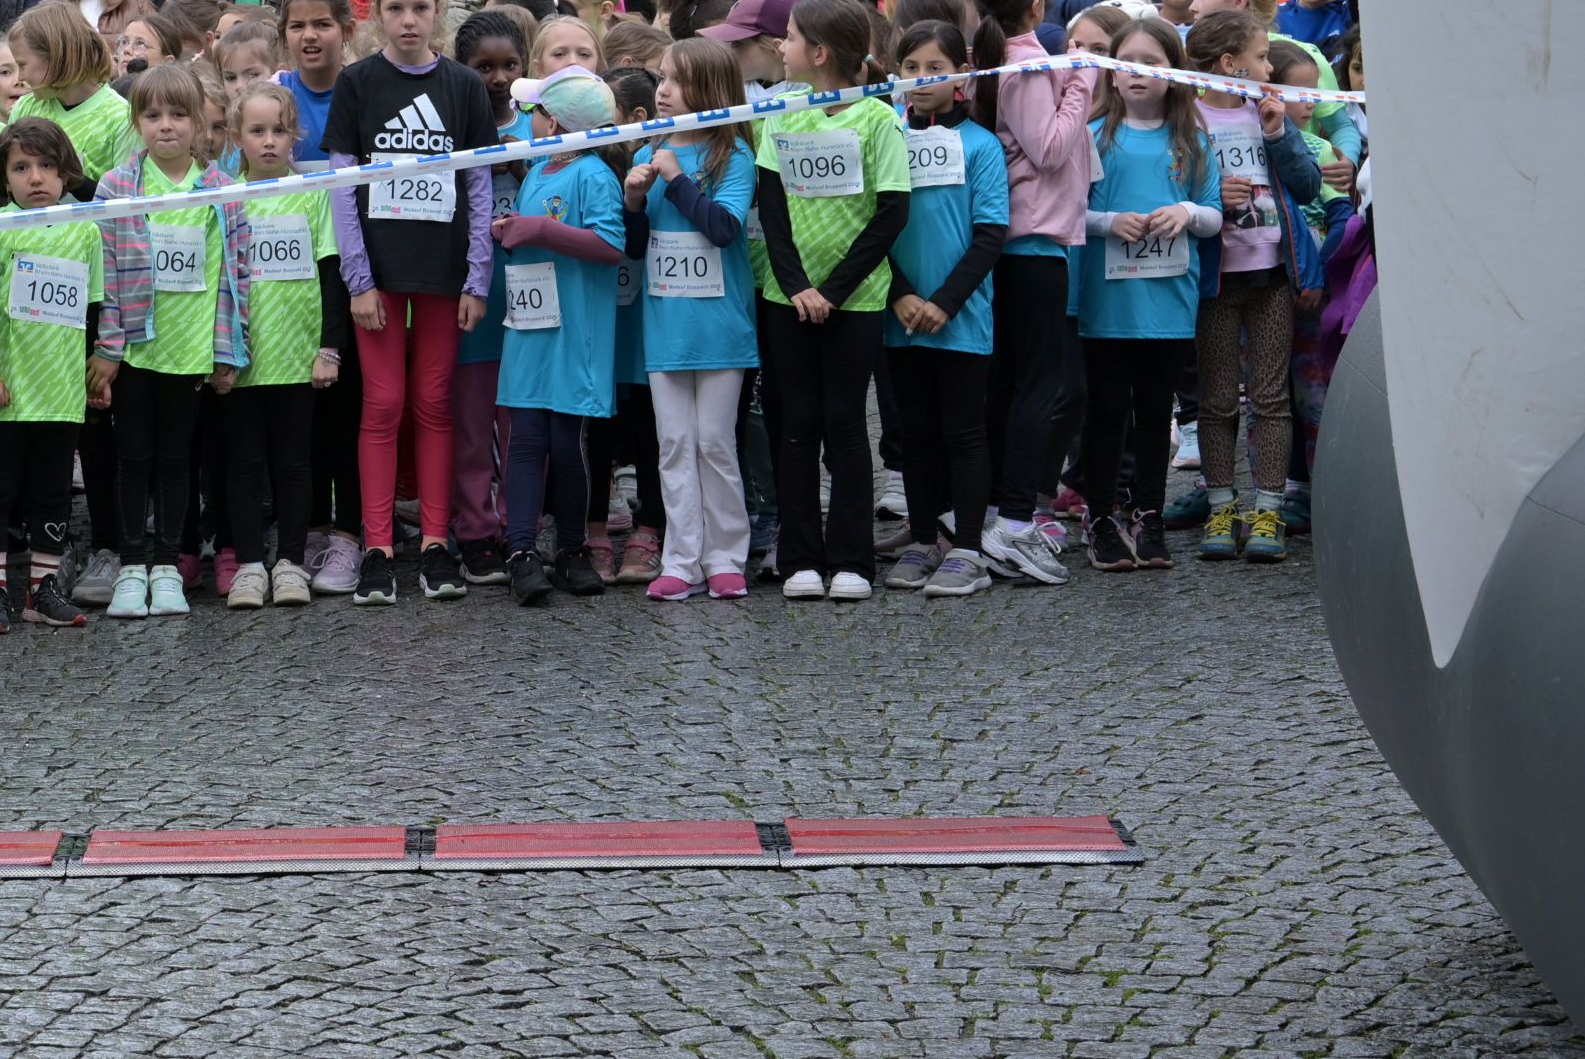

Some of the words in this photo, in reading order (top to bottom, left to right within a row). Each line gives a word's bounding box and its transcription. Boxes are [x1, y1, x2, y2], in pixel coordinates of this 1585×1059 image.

[375, 128, 454, 152] adidas
[789, 155, 846, 178] 1096
[1216, 147, 1266, 169] 1316
[387, 179, 443, 202] 1282
[250, 239, 301, 262] 1066
[1121, 237, 1176, 259] 1247
[156, 250, 195, 272] 064
[656, 255, 707, 277] 1210
[28, 280, 78, 307] 1058
